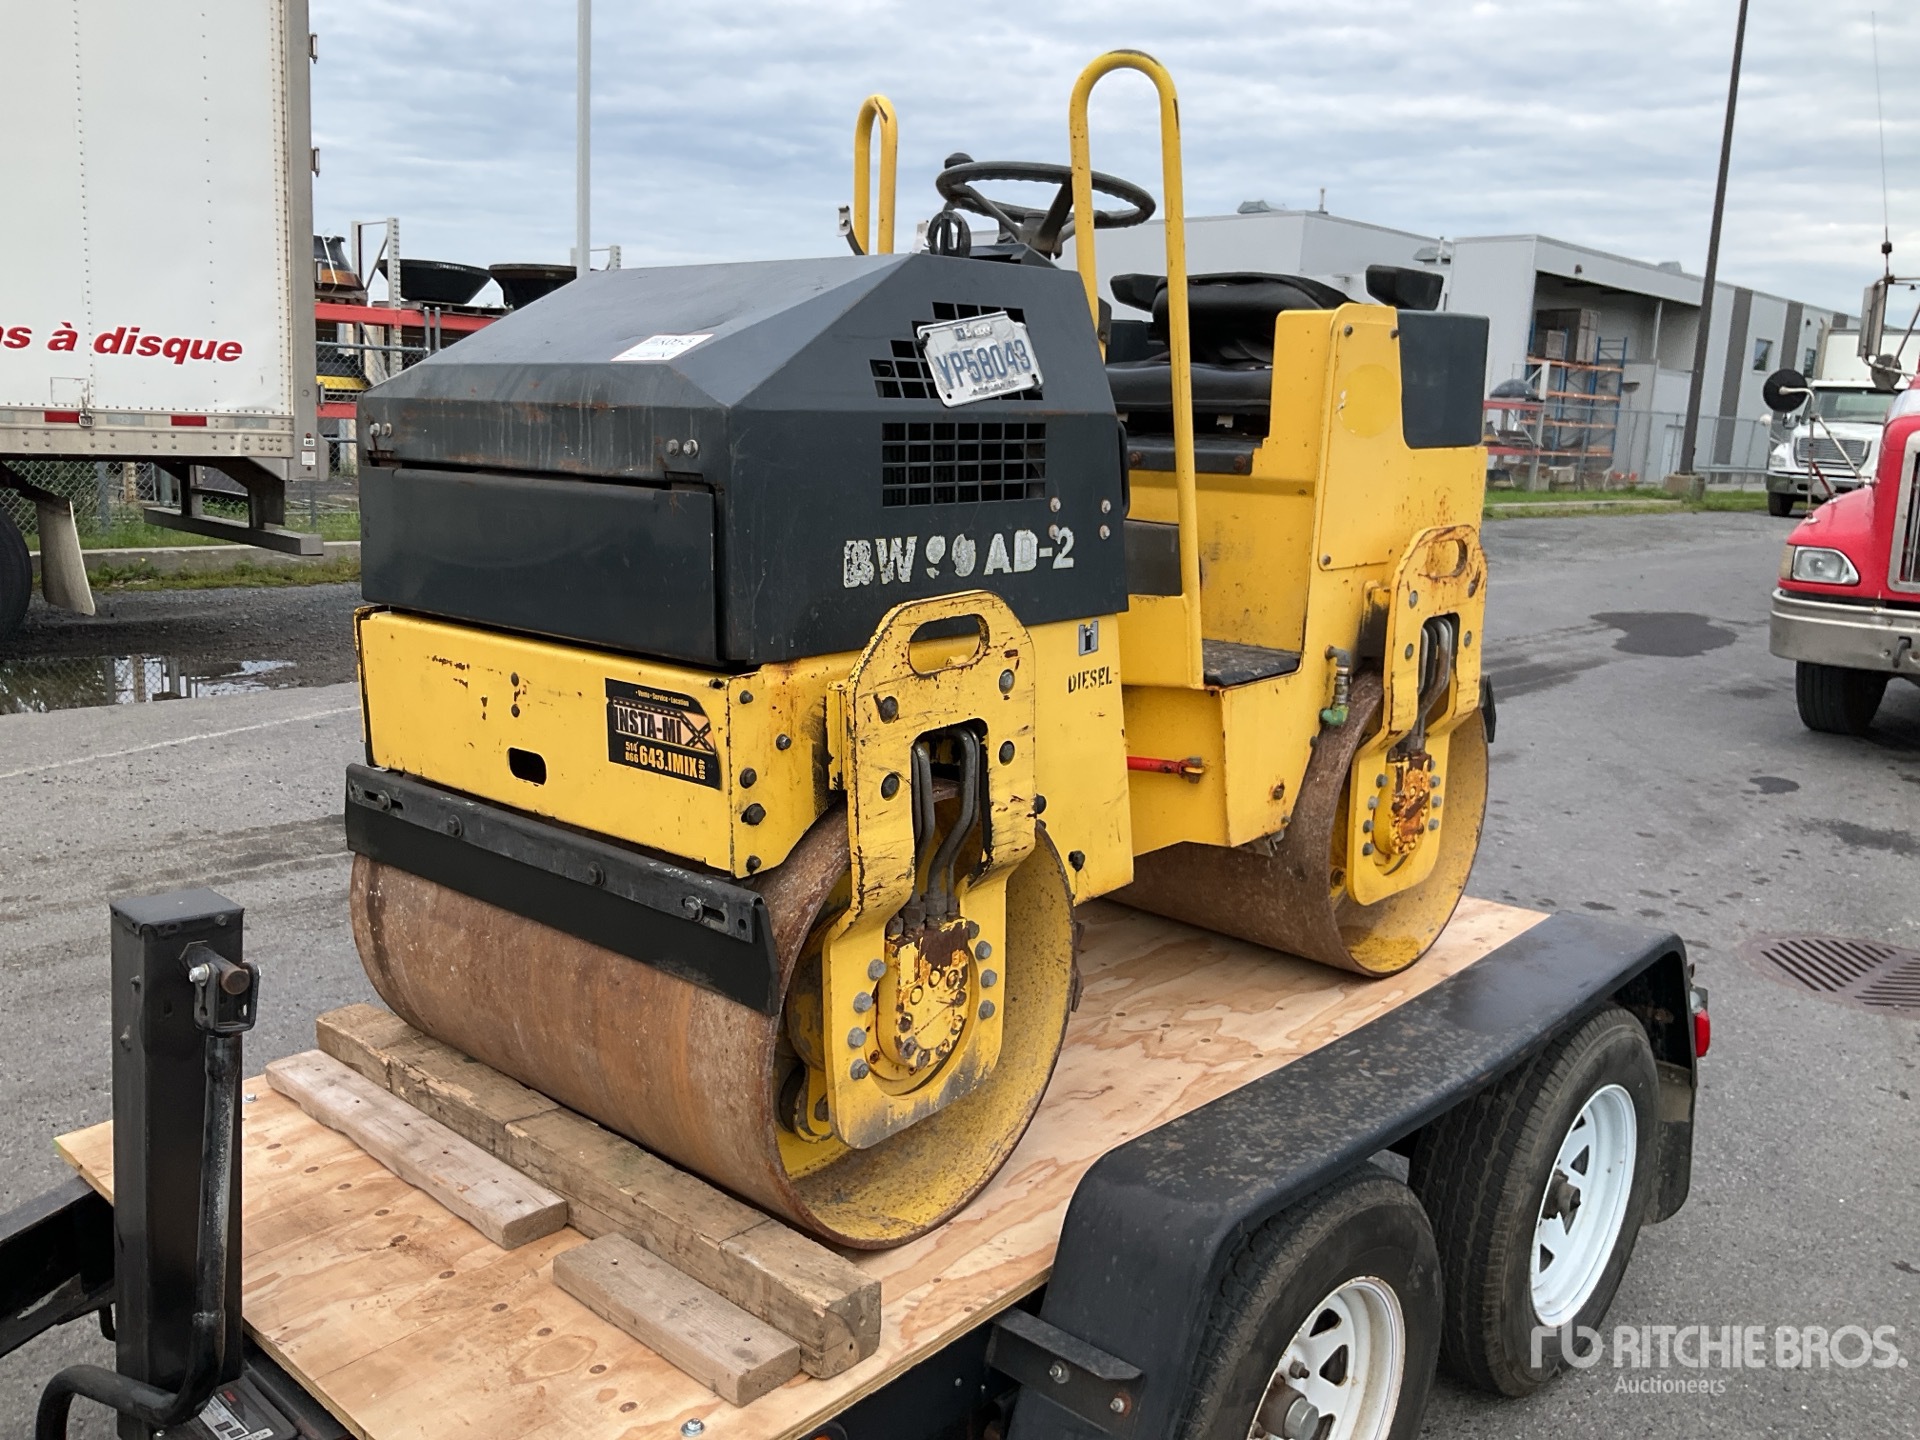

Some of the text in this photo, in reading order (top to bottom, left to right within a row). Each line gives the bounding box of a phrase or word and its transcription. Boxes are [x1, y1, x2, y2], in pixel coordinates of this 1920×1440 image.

[0, 322, 243, 365] s à disque
[1068, 666, 1113, 694] DIESEL
